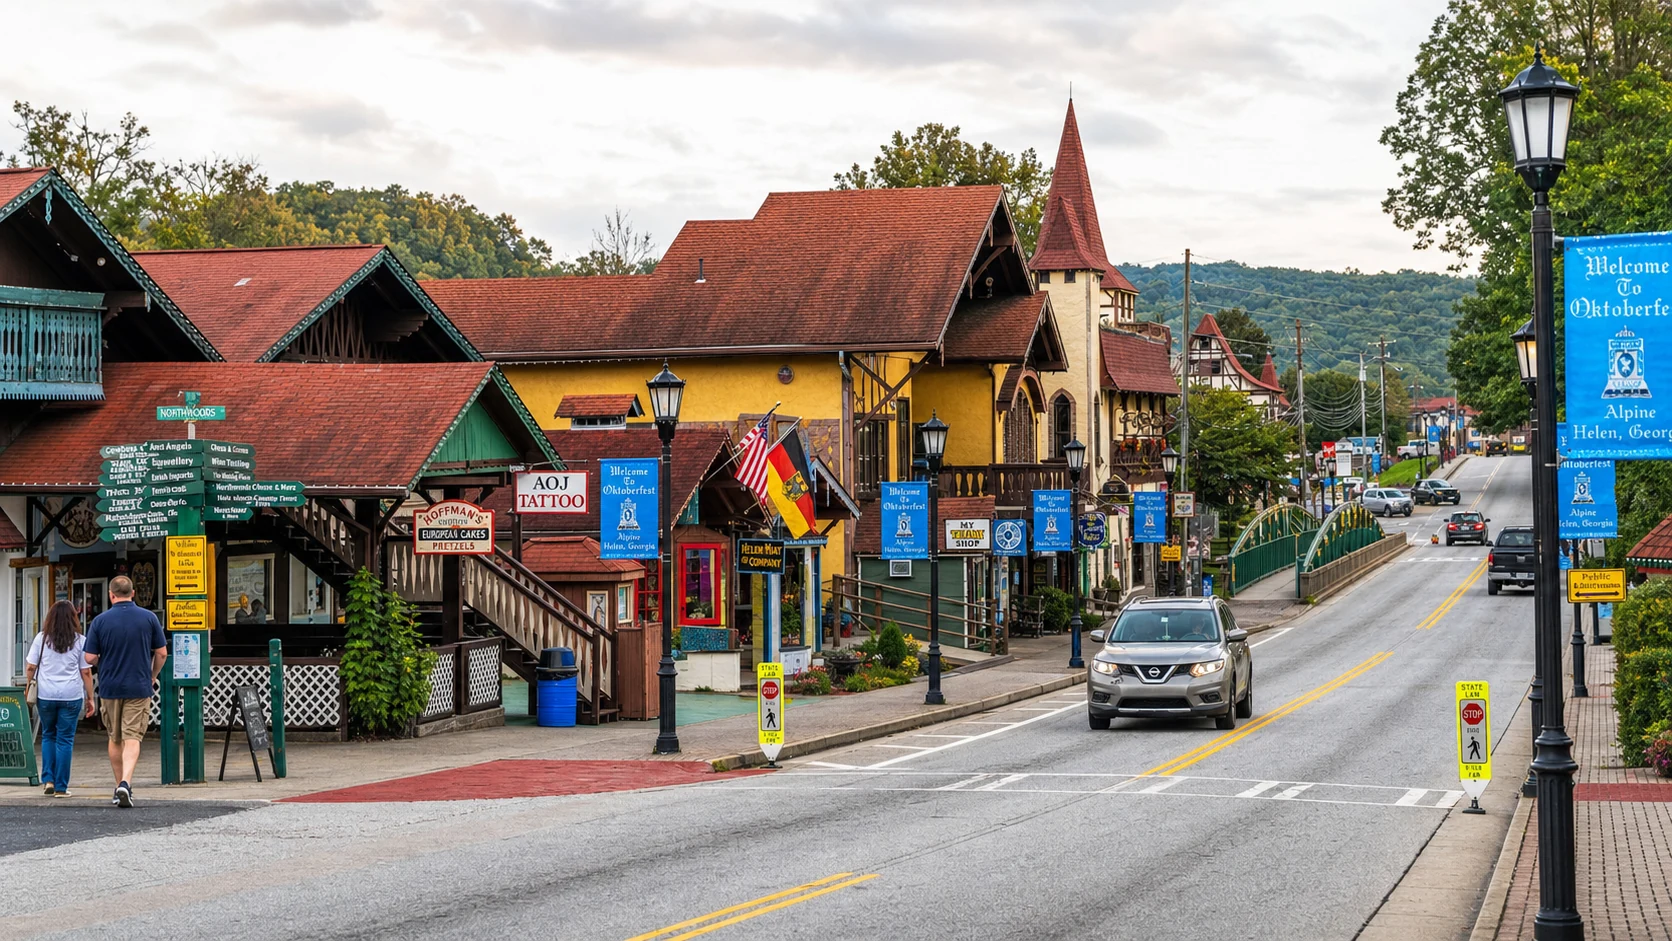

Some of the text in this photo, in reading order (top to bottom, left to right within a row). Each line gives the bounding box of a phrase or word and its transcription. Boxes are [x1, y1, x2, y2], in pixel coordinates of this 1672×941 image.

[1583, 255, 1670, 281] Welcome
[1615, 277, 1642, 297] To
[1603, 403, 1657, 423] Alpine
[1573, 424, 1622, 441] Helen,
[610, 465, 649, 476] Welcome
[533, 475, 570, 491] AOJ
[602, 484, 656, 496] Oktoberfest
[518, 493, 585, 508] TATTOO
[423, 505, 484, 526] HOFFMAN'S
[460, 529, 486, 539] CAKES
[432, 541, 475, 551] PRETZELS
[1461, 683, 1483, 691] STATE
[1463, 709, 1483, 719] STOP
